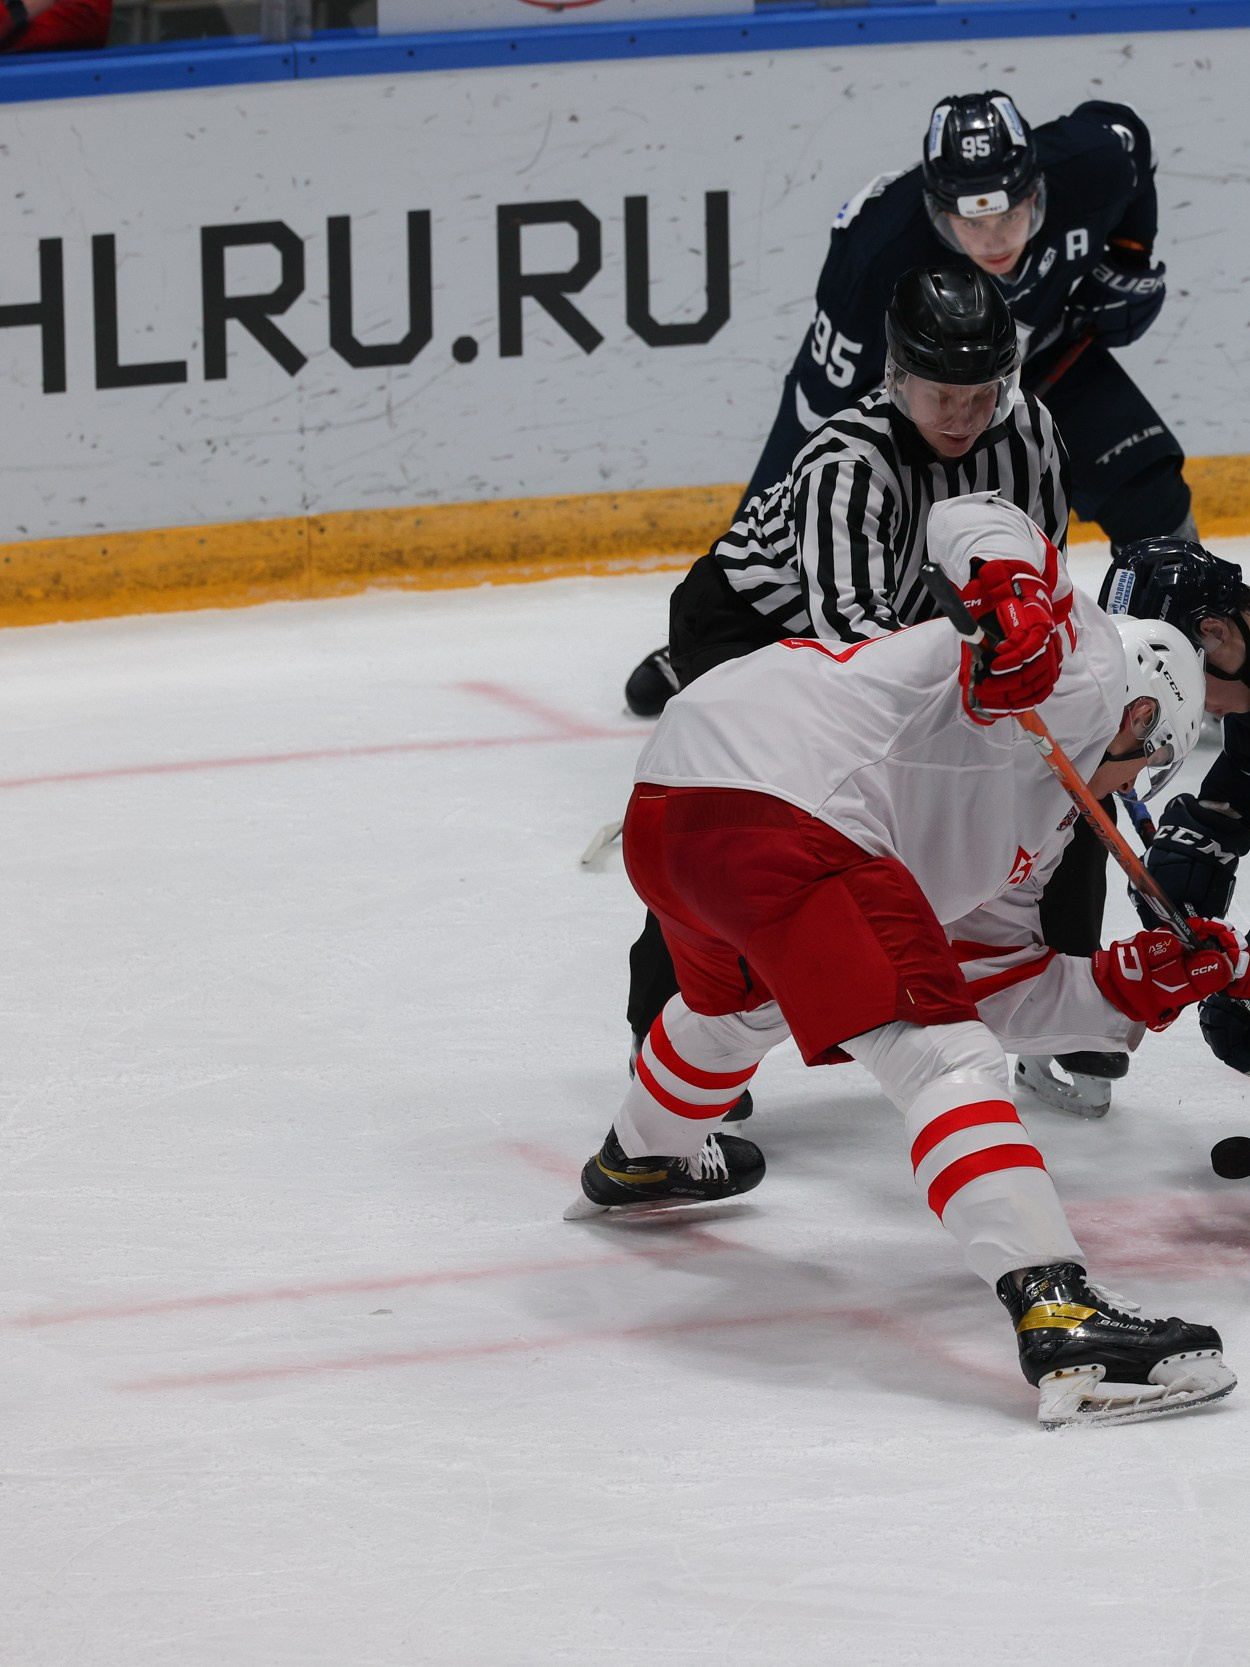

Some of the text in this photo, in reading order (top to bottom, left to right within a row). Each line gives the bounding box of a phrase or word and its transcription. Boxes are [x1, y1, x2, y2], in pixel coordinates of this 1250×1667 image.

[961, 134, 991, 161] 95
[1065, 228, 1090, 261] A
[1092, 262, 1165, 294] AUER
[811, 309, 863, 389] 95
[1095, 424, 1165, 464] TRUE
[963, 598, 982, 609] CM
[1159, 594, 1173, 621] UER
[1163, 670, 1184, 702] CCM
[1153, 824, 1237, 865] CCM
[1191, 963, 1219, 976] CCM
[1098, 1318, 1149, 1333] BAUER
